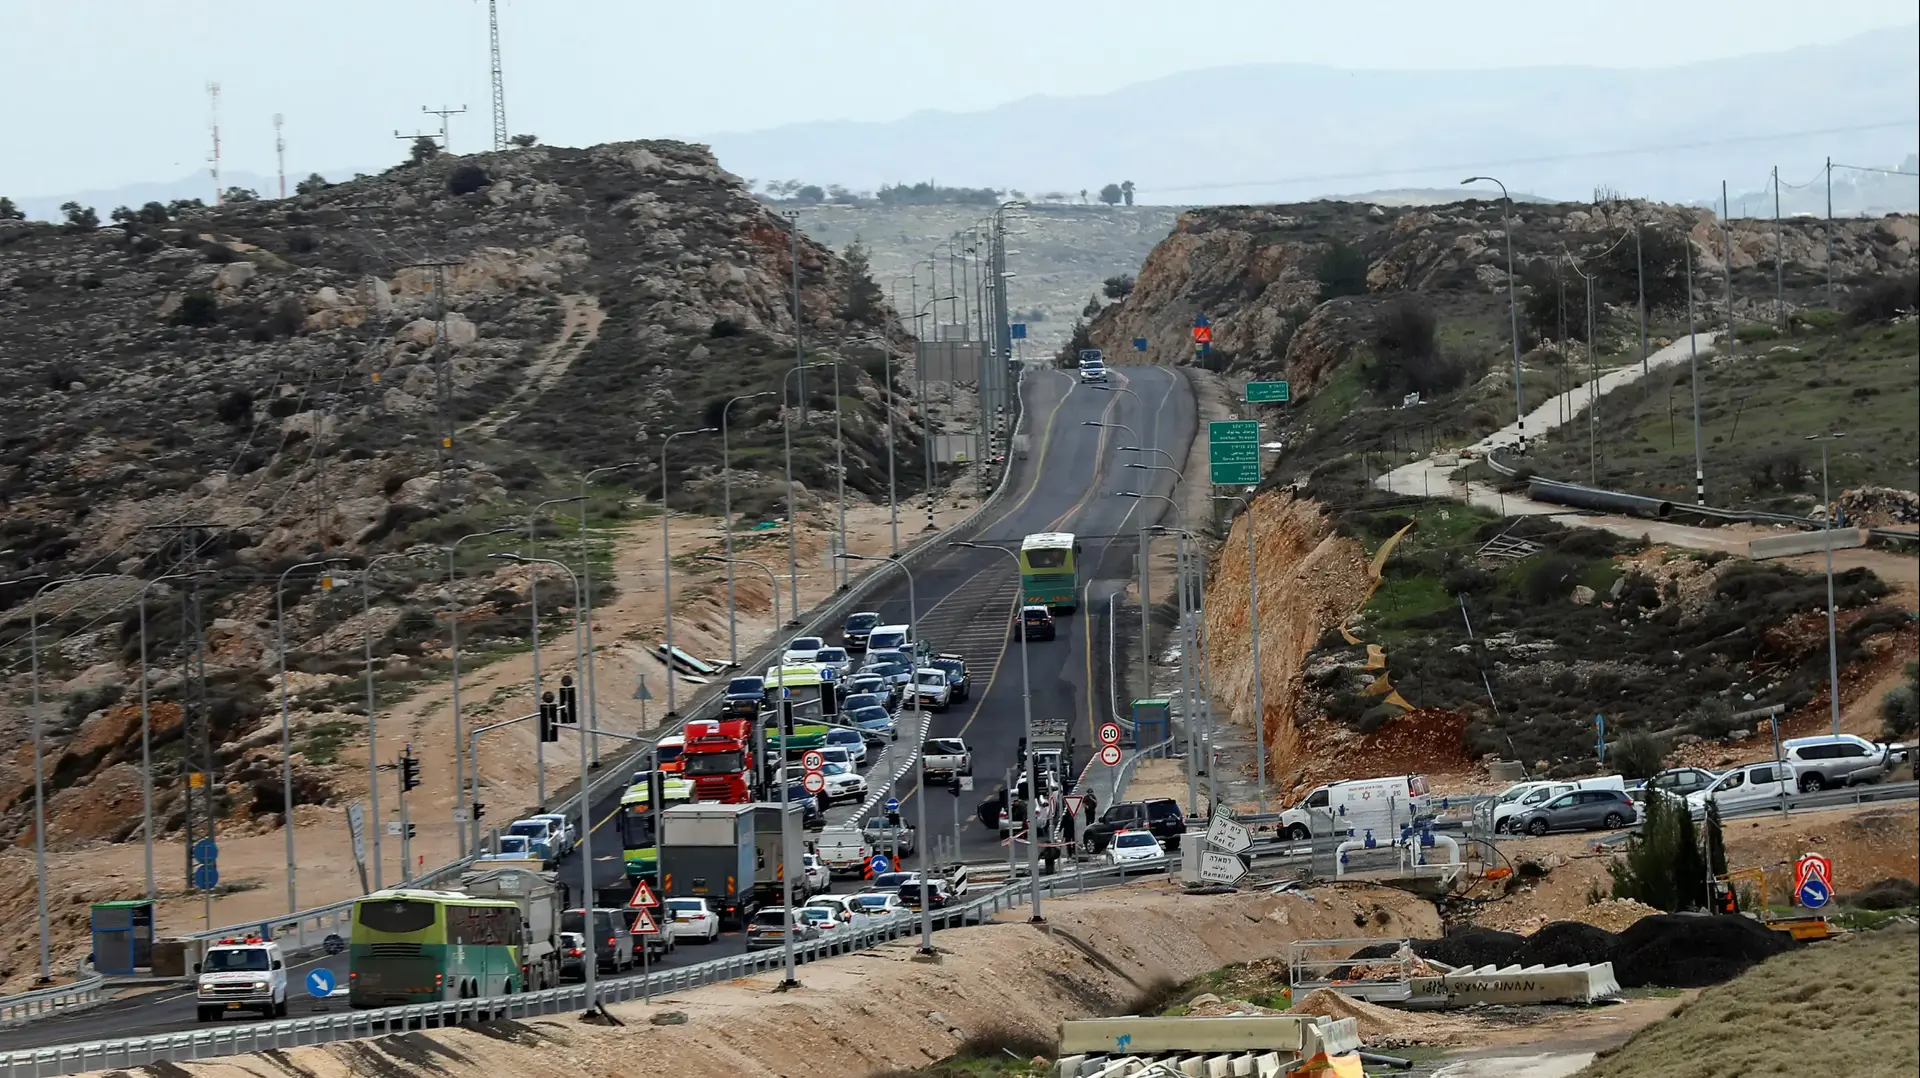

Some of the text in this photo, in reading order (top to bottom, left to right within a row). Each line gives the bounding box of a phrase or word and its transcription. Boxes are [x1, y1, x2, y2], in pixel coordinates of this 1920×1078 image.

[1103, 729, 1116, 739] 60
[806, 756, 820, 766] 60
[1219, 819, 1242, 835] בית אל
[1213, 835, 1225, 844] Bet
[1209, 855, 1232, 864] רמאלה
[1203, 870, 1234, 880] Ramallah
